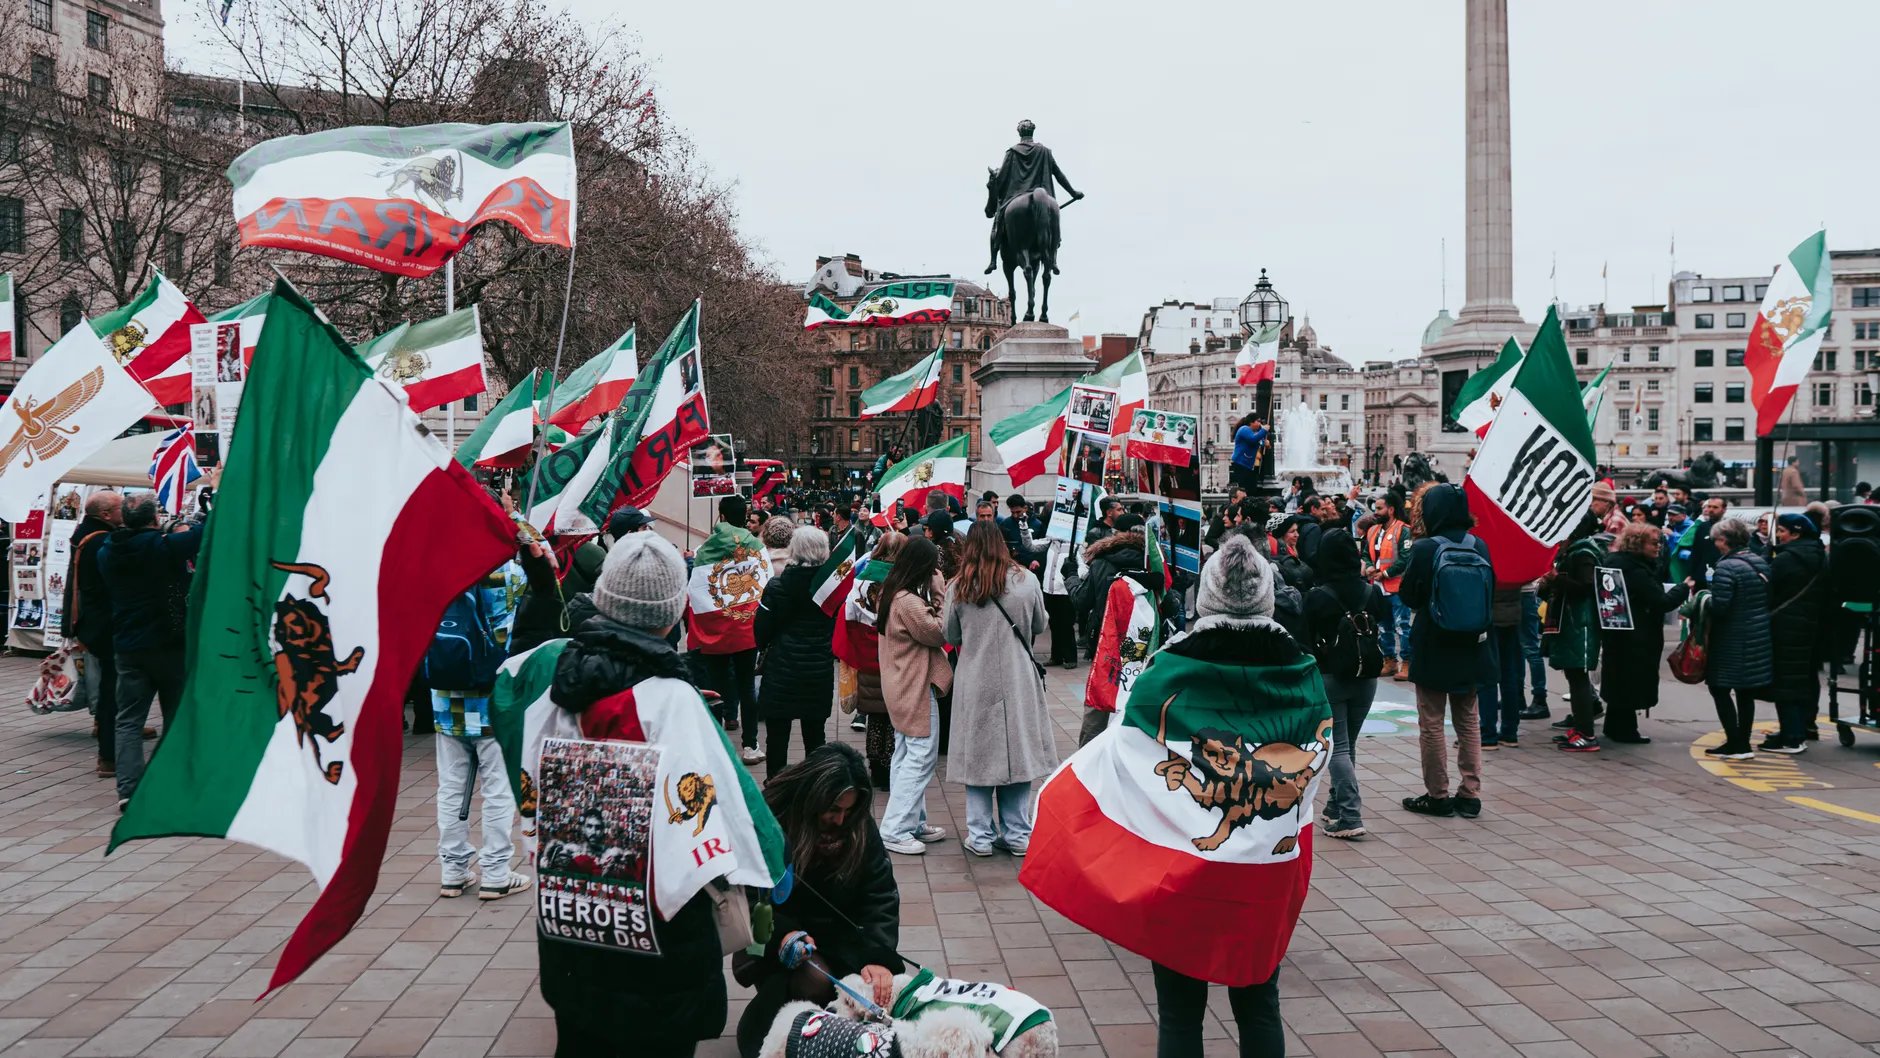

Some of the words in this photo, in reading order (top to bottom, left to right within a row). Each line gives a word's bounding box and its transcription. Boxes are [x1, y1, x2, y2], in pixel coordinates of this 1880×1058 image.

[691, 837, 733, 868] IR
[541, 895, 647, 933] HEROES
[543, 917, 606, 943] Never
[613, 929, 652, 951] Die
